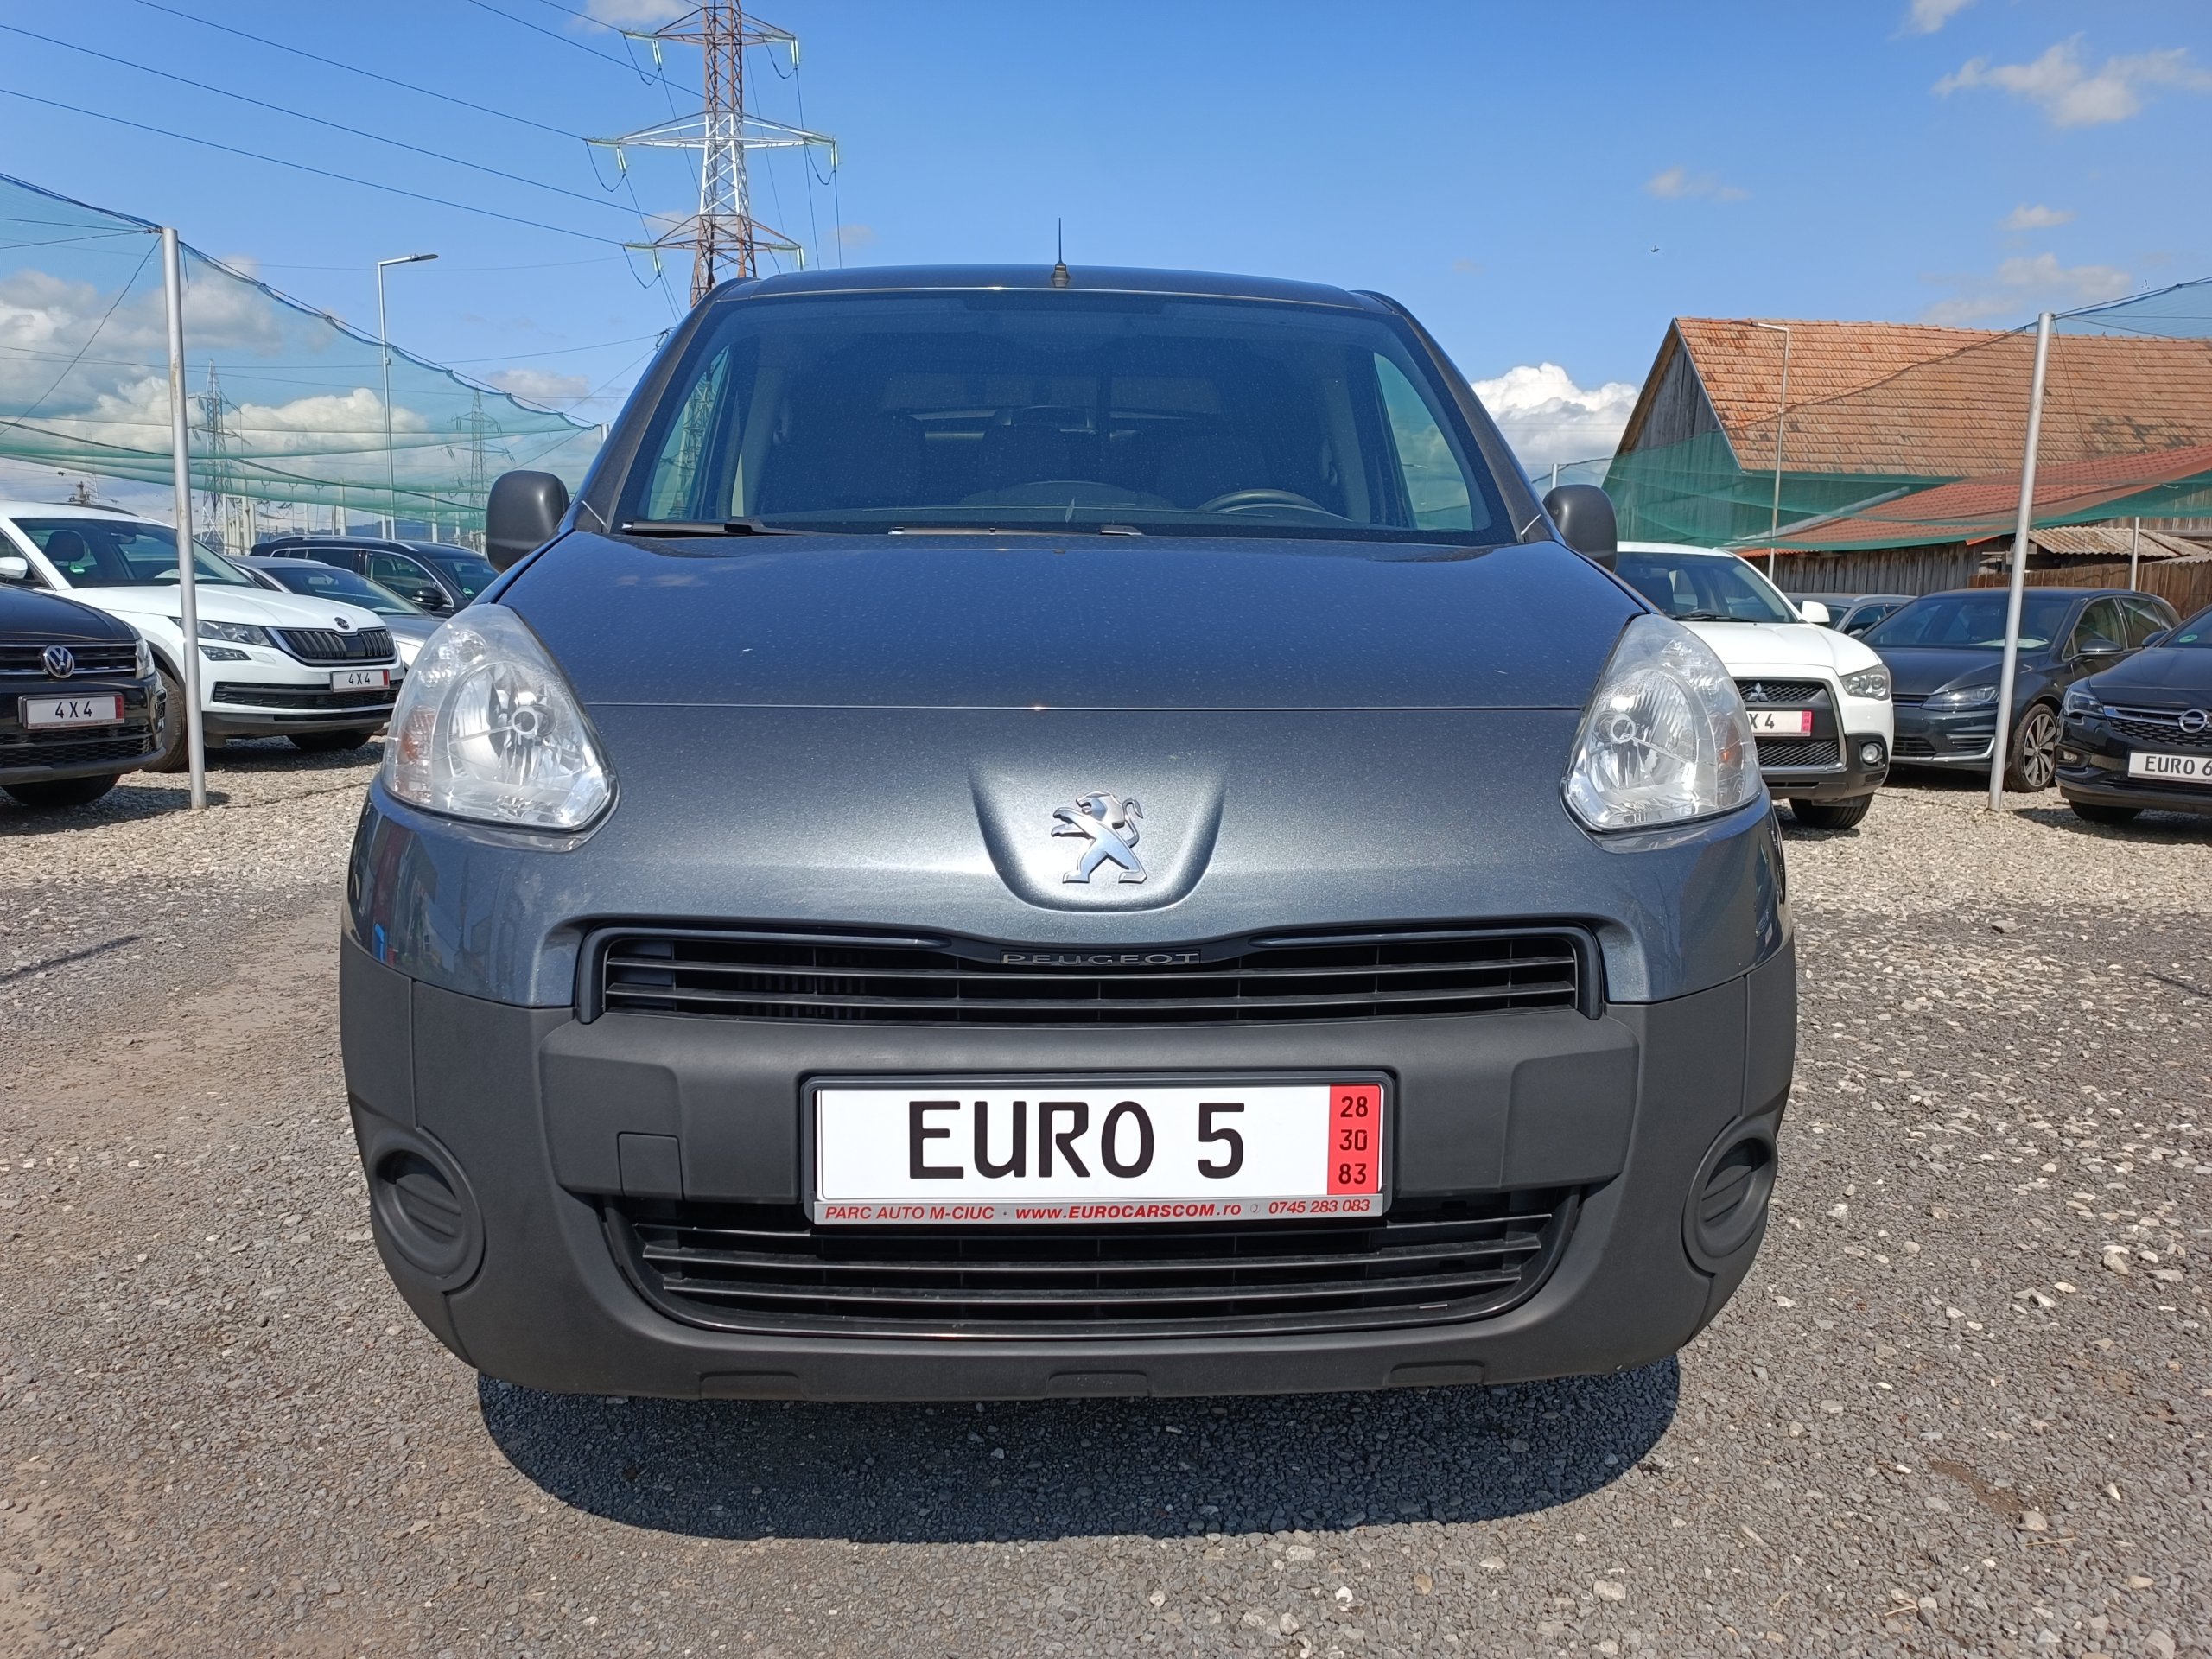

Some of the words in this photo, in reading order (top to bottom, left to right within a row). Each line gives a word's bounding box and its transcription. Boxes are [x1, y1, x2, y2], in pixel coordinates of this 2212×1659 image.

[54, 702, 65, 718] 4
[83, 700, 92, 717] 4
[1764, 713, 1775, 729] 4
[2145, 755, 2196, 775] EURO
[2202, 760, 2212, 777] 6
[1001, 953, 1199, 965] PEUGEOT
[1339, 1096, 1370, 1118] 28
[909, 1100, 1154, 1179] EURO
[1198, 1102, 1245, 1179] 5
[1338, 1128, 1368, 1152] 30
[1337, 1162, 1367, 1185] 83
[824, 1206, 872, 1220] PARC
[875, 1206, 925, 1220] AUTO
[929, 1206, 995, 1220] M-CIUC
[1014, 1204, 1242, 1220] www.EUROCARSCOM.ro
[1268, 1201, 1306, 1215] 0745
[1309, 1200, 1338, 1213] 283
[1342, 1198, 1371, 1212] 083
